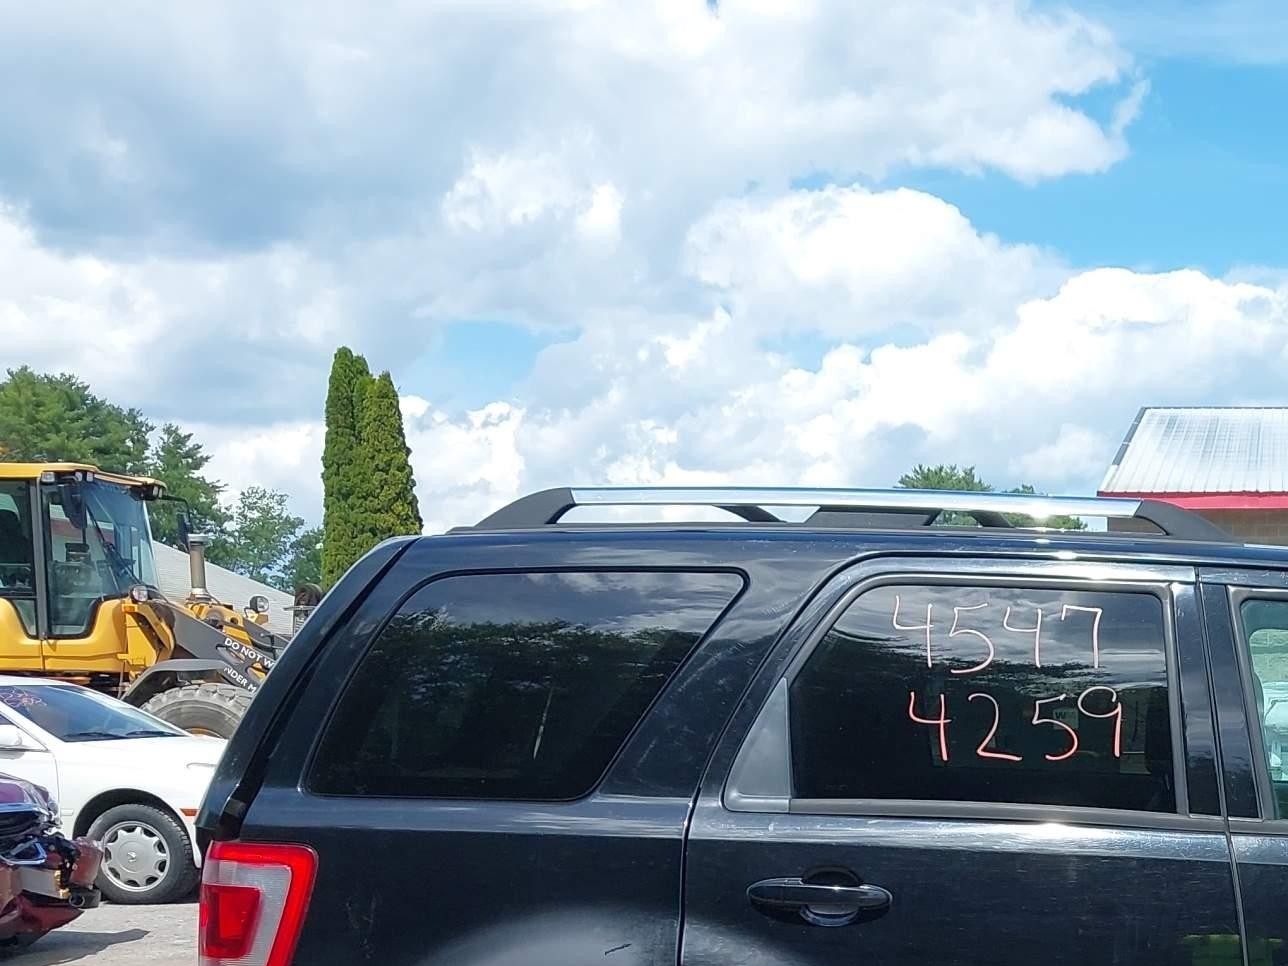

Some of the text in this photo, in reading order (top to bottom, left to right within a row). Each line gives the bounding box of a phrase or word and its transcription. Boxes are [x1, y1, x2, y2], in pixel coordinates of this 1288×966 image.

[224, 637, 240, 650] DO
[240, 646, 263, 662] NOT
[892, 595, 1102, 673] 4547
[909, 686, 1122, 761] 4259
